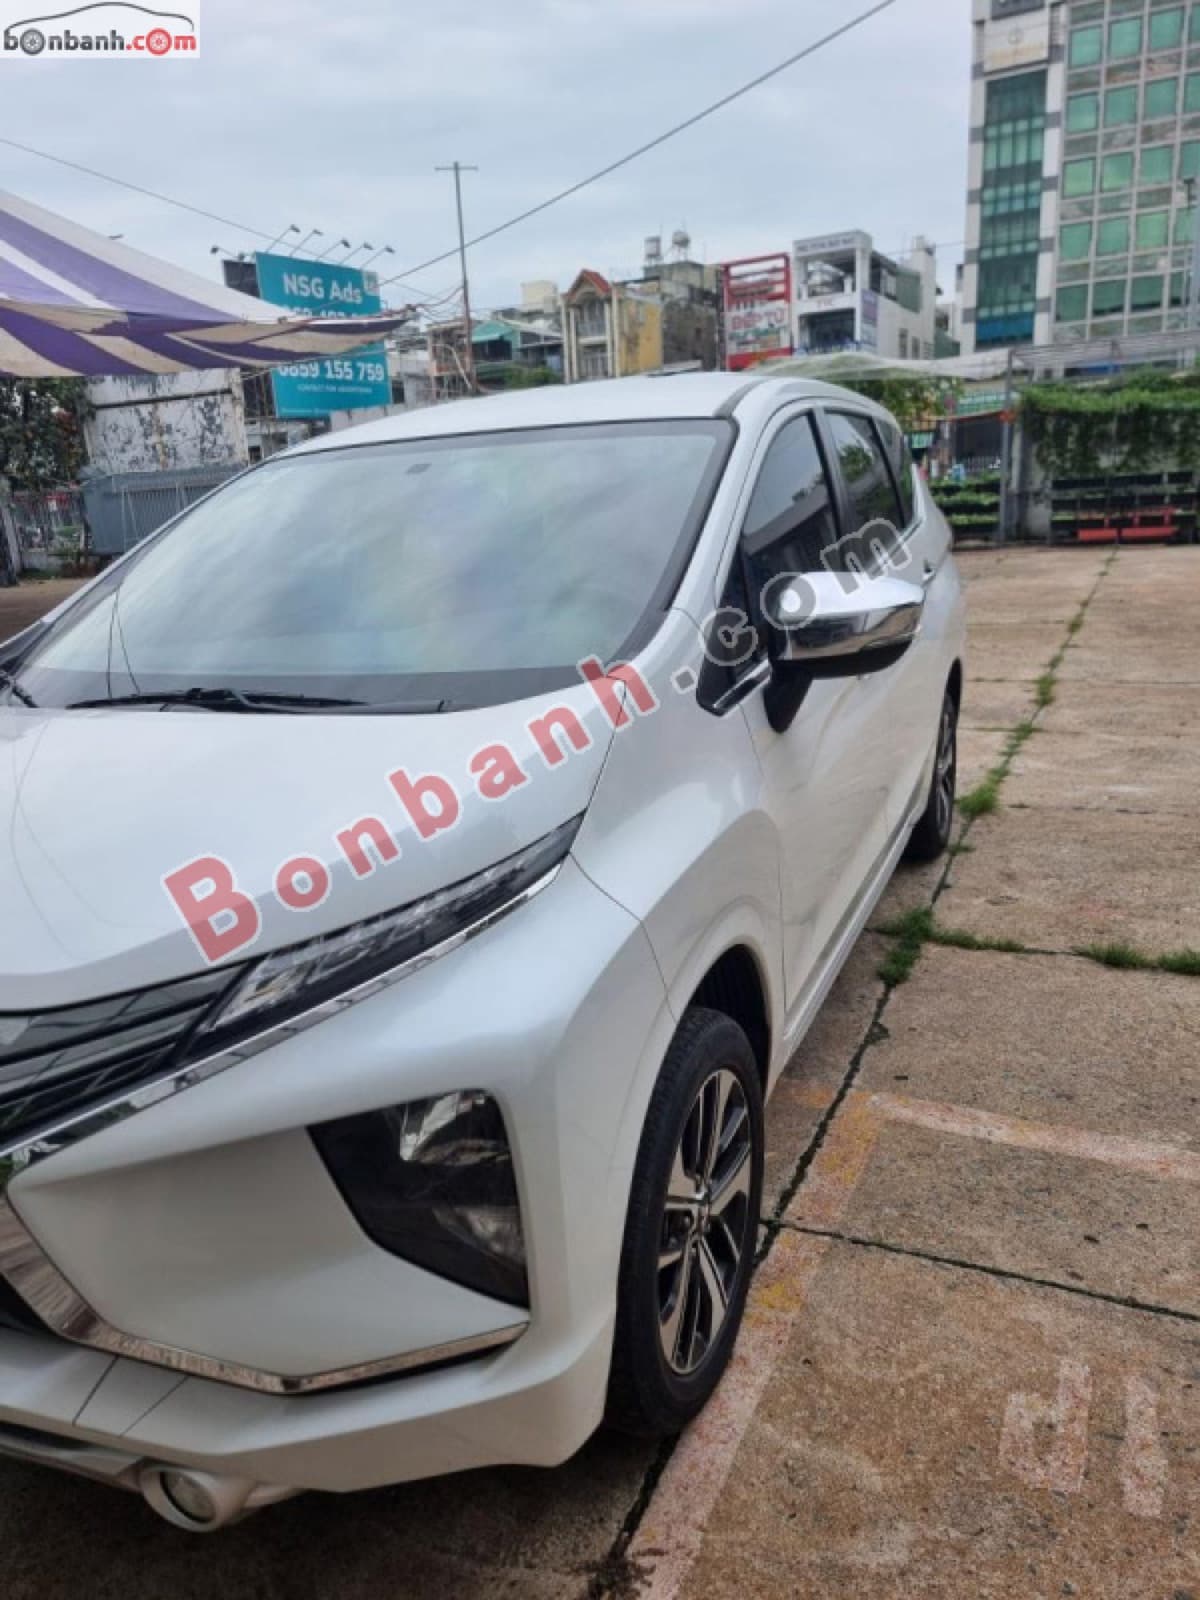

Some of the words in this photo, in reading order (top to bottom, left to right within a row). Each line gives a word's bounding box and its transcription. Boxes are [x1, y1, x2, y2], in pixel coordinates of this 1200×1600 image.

[282, 271, 326, 300] NSG
[329, 280, 363, 304] Ads
[324, 360, 353, 380] 155
[356, 362, 385, 381] 759
